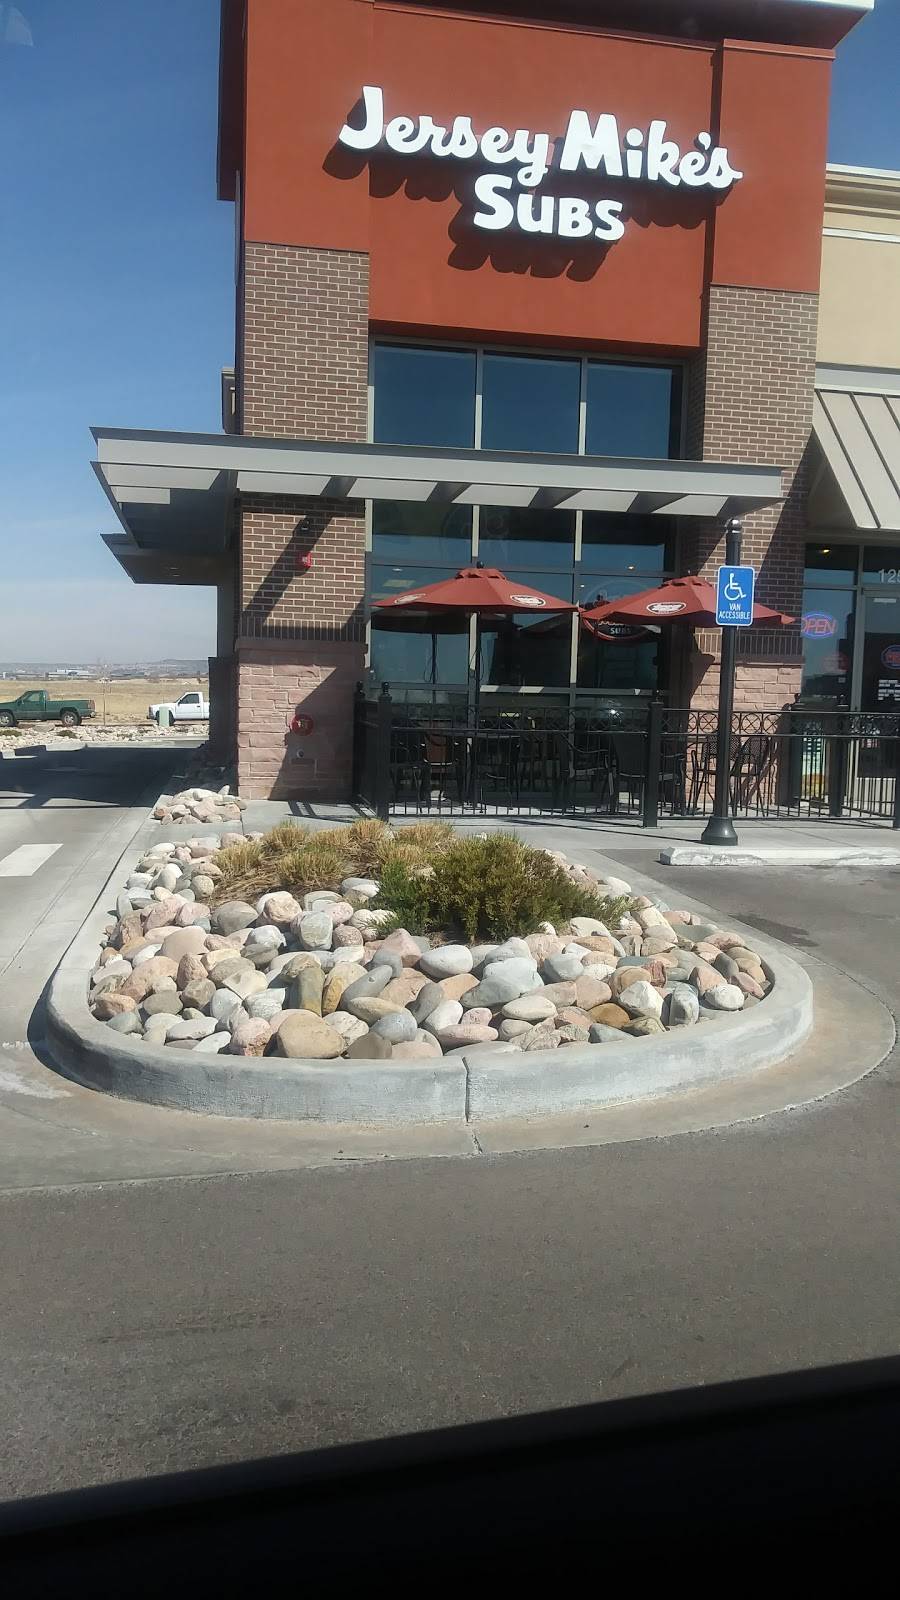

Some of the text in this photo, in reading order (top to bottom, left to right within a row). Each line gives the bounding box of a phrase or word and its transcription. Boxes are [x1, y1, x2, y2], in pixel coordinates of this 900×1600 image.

[339, 86, 743, 189] Jersey Mike's
[473, 174, 625, 241] SUBS
[719, 611, 751, 620] ACCESSIBLE
[729, 603, 741, 611] VAN
